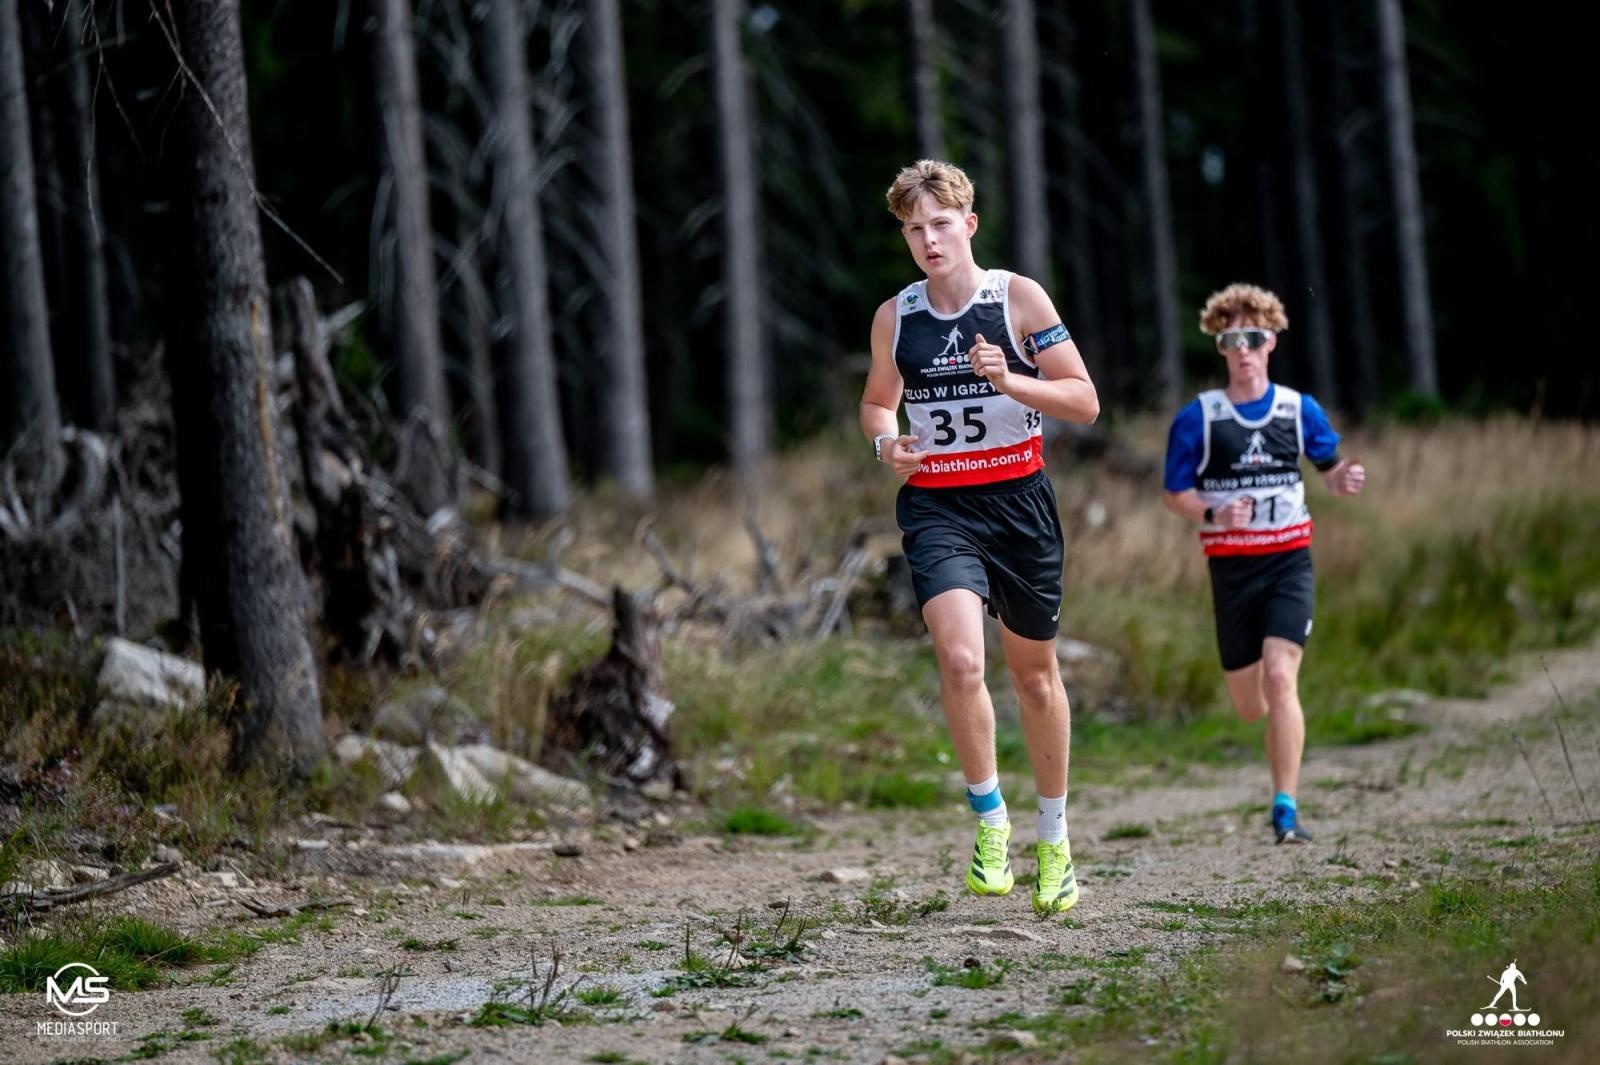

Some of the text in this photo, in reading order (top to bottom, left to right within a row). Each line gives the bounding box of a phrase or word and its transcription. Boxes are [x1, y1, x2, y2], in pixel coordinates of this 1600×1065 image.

[933, 386, 948, 398] W
[952, 382, 996, 396] IGRZY
[929, 406, 987, 446] 35
[1025, 410, 1040, 430] 35
